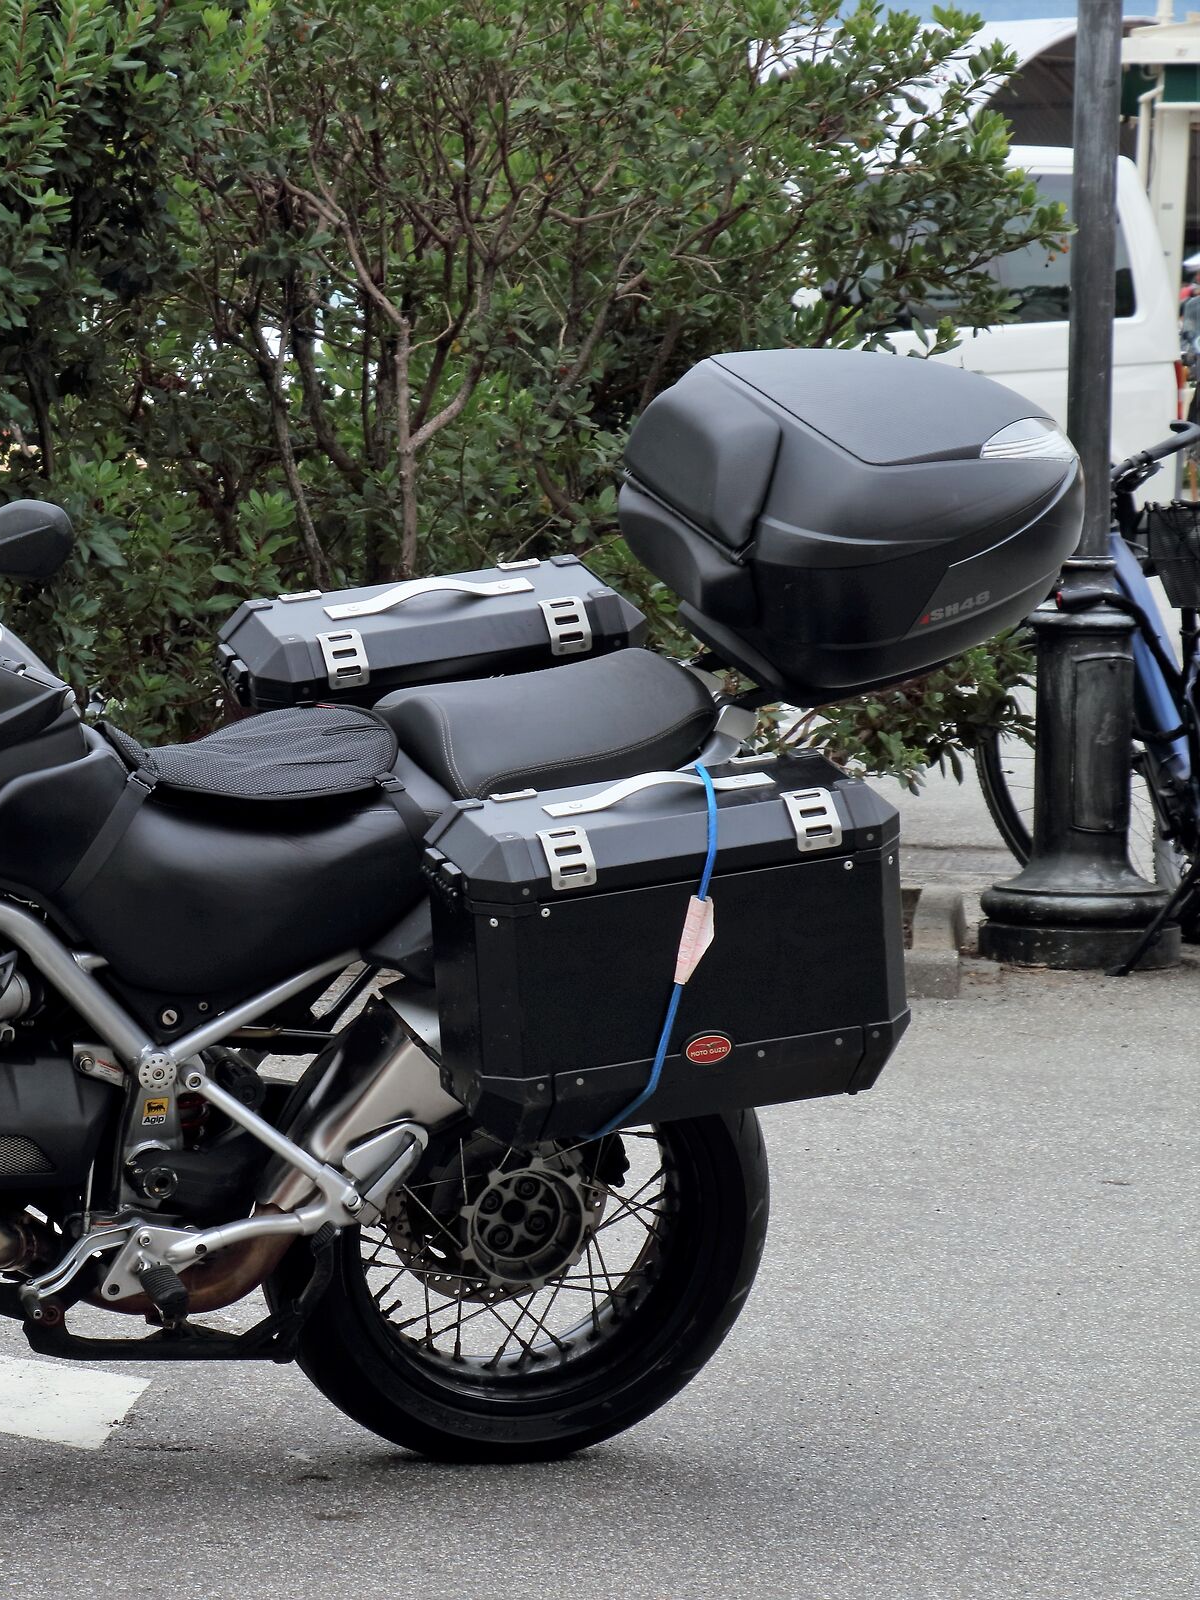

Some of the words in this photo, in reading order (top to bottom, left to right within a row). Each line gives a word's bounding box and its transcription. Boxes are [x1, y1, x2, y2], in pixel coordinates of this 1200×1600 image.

[930, 590, 991, 621] SH48
[690, 1049, 709, 1058] MOTO
[709, 1046, 728, 1055] GUZZI
[143, 1116, 165, 1124] Agip
